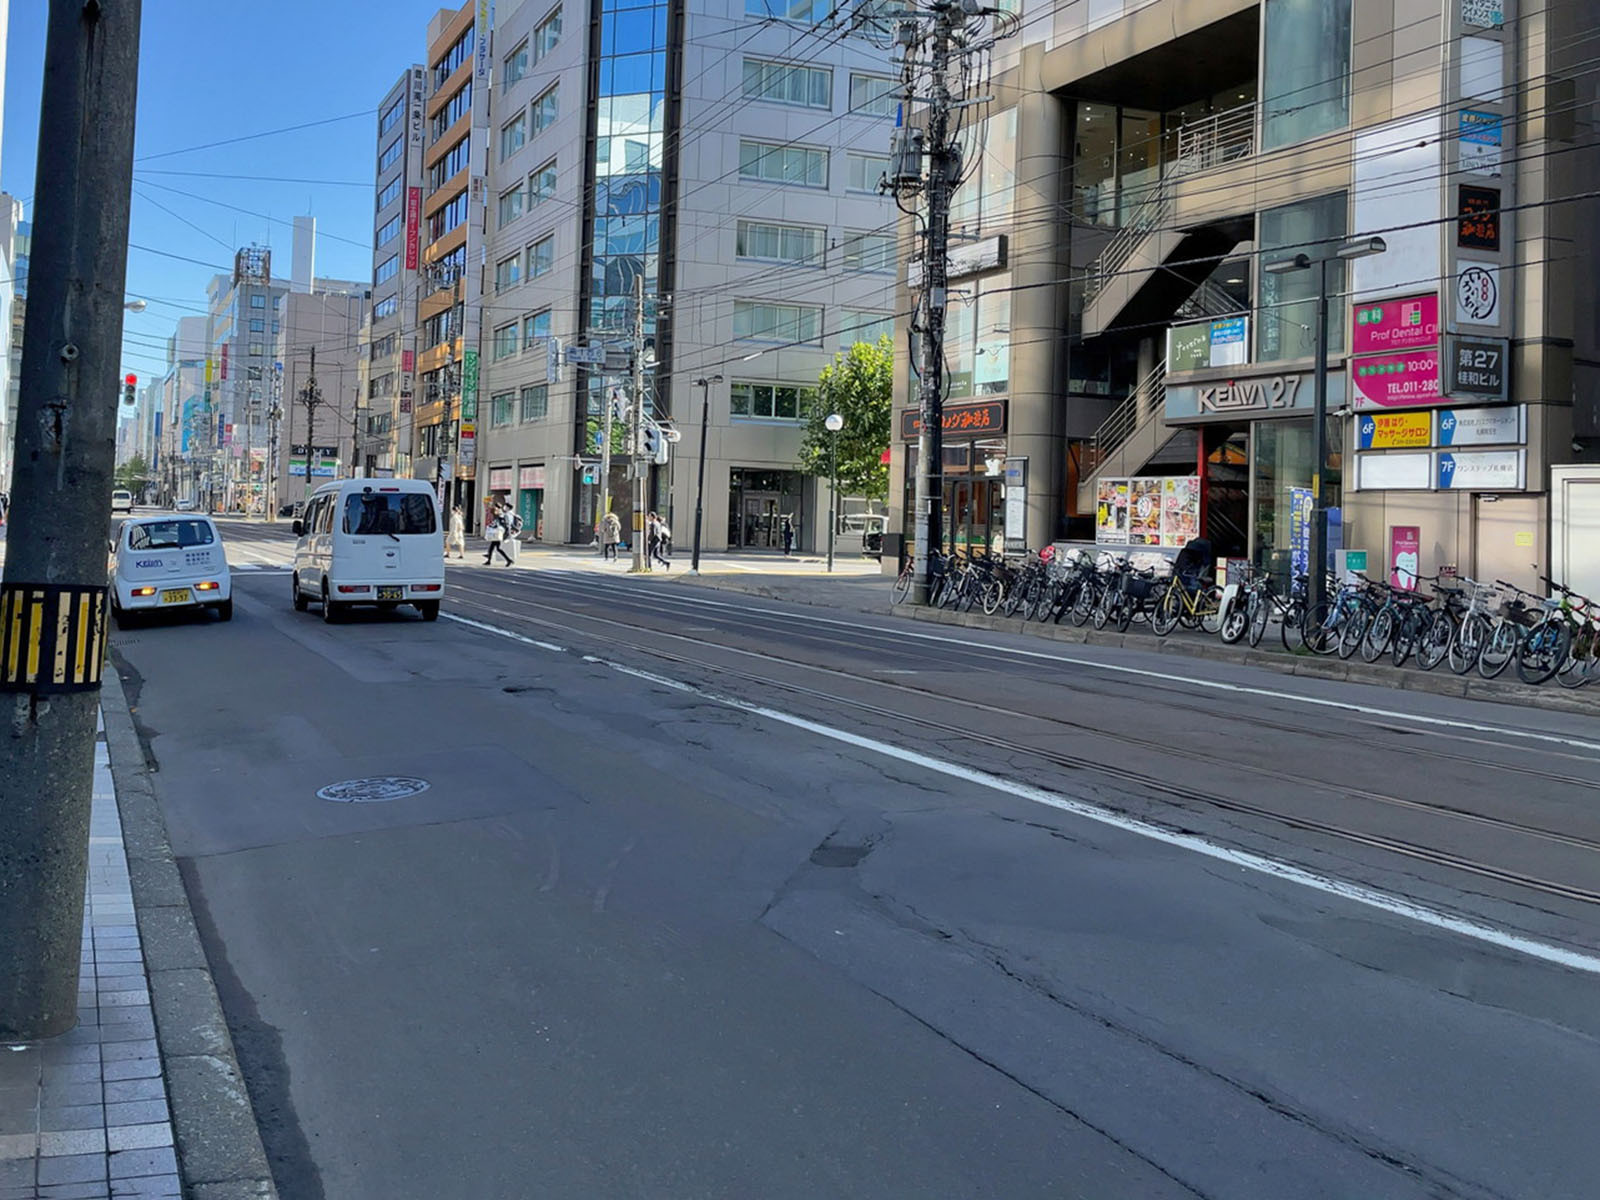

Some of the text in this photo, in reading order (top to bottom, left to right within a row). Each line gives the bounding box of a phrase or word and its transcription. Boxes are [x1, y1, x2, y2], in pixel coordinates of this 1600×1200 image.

[1370, 330, 1389, 341] Prof
[1391, 326, 1423, 339] Dental
[1459, 349, 1498, 369] 第27
[1457, 371, 1500, 387] 桂和ビル
[1271, 375, 1301, 408] 27
[1362, 423, 1374, 434] 6F
[1441, 418, 1455, 430] 6F
[1377, 427, 1429, 439] マッサージサロン
[1441, 461, 1454, 473] 7F
